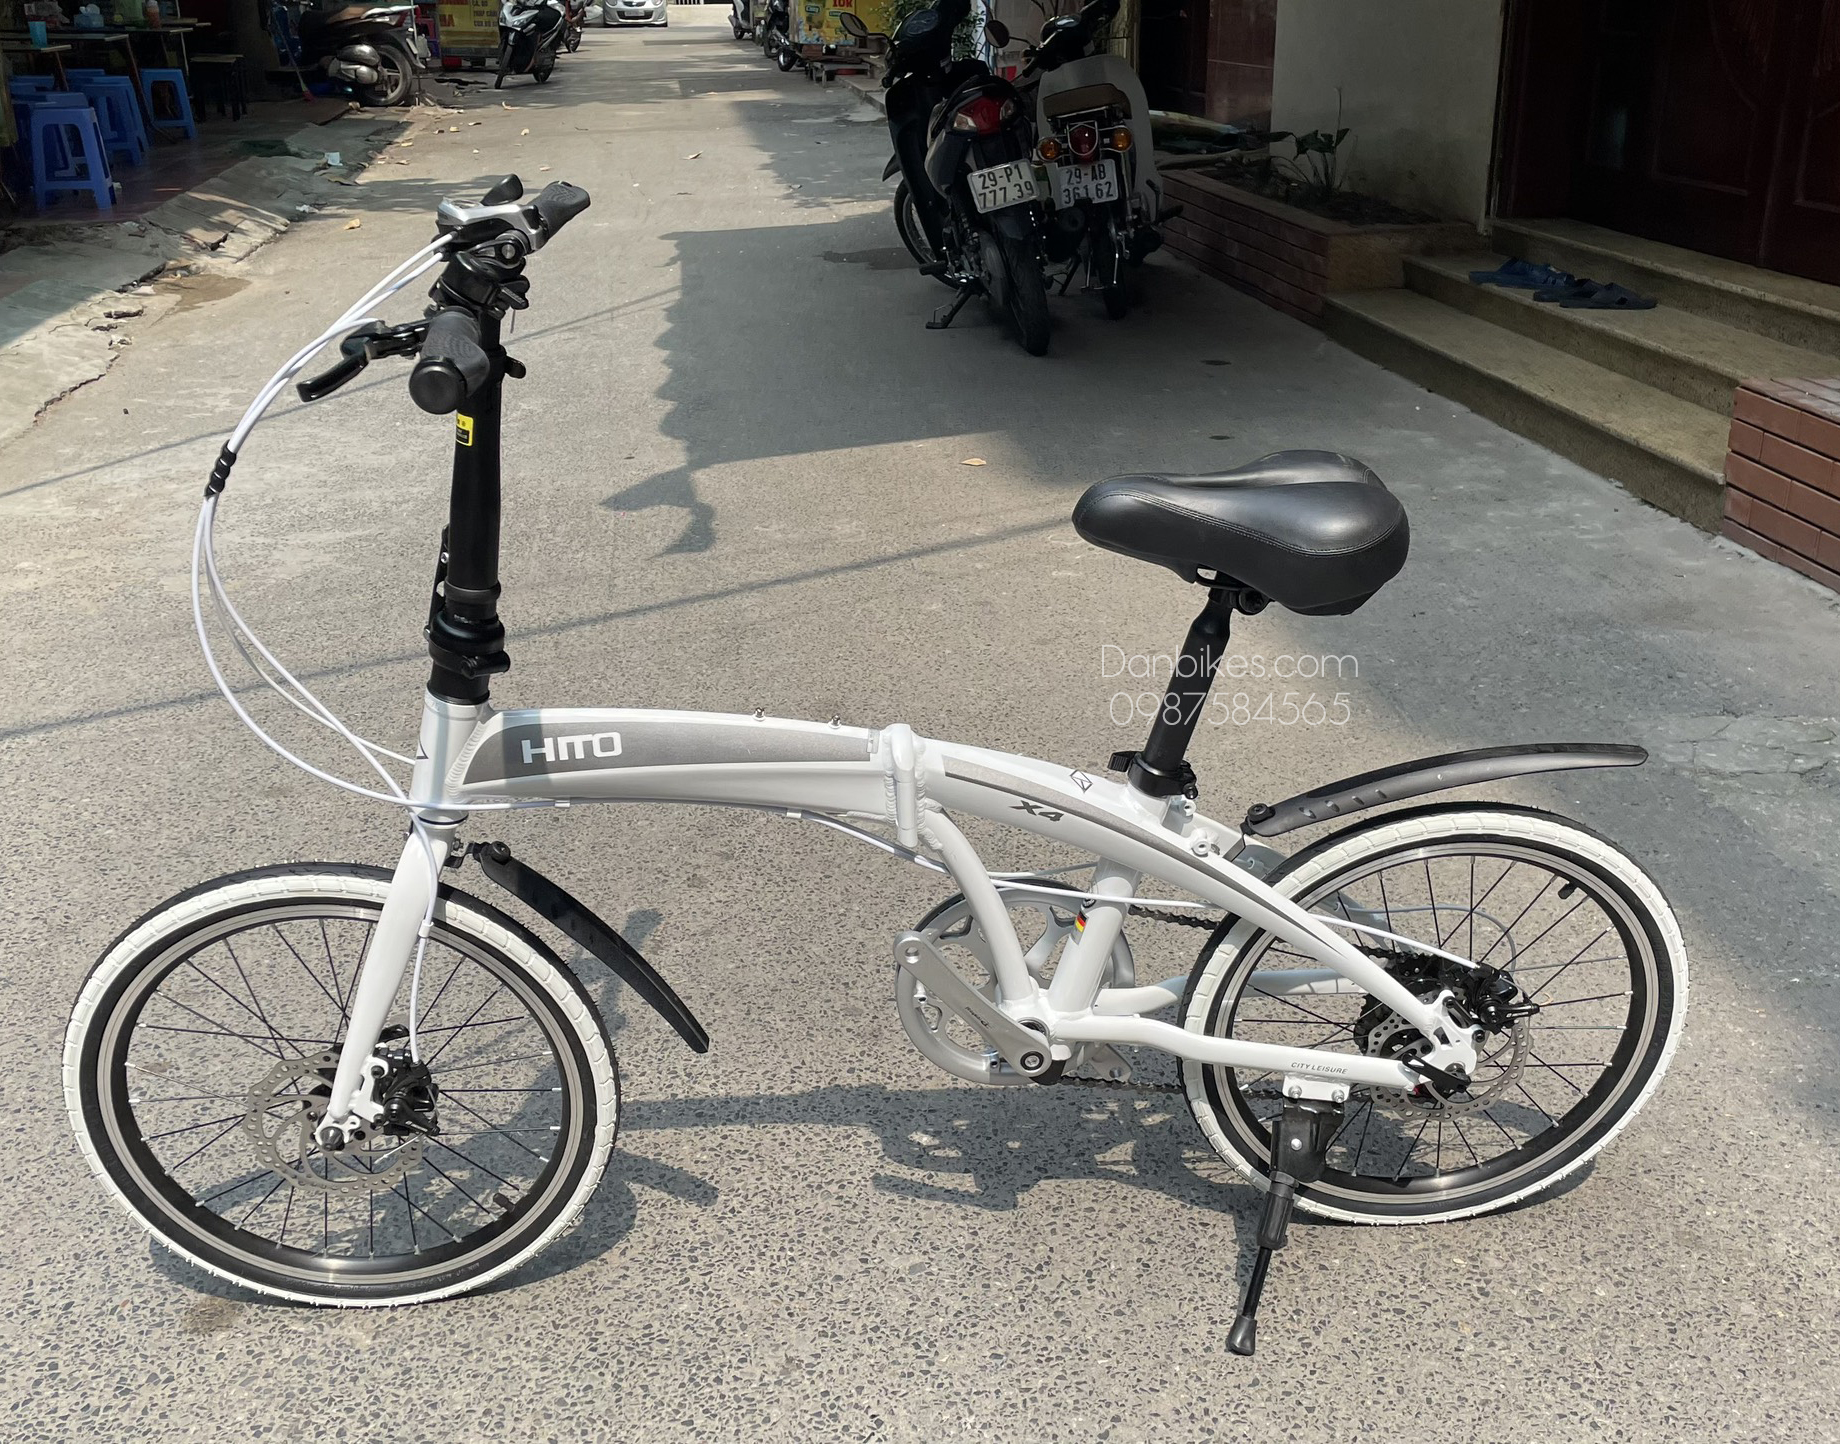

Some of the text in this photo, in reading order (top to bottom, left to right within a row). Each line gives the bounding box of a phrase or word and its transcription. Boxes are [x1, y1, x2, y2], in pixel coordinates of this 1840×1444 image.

[978, 164, 1023, 190] 29-P1
[978, 180, 1035, 209] 777.39
[1062, 181, 1114, 204] 361.62
[521, 731, 622, 764] HITO
[1008, 799, 1065, 822] X4
[1290, 1061, 1349, 1075] CITY LEISURE
